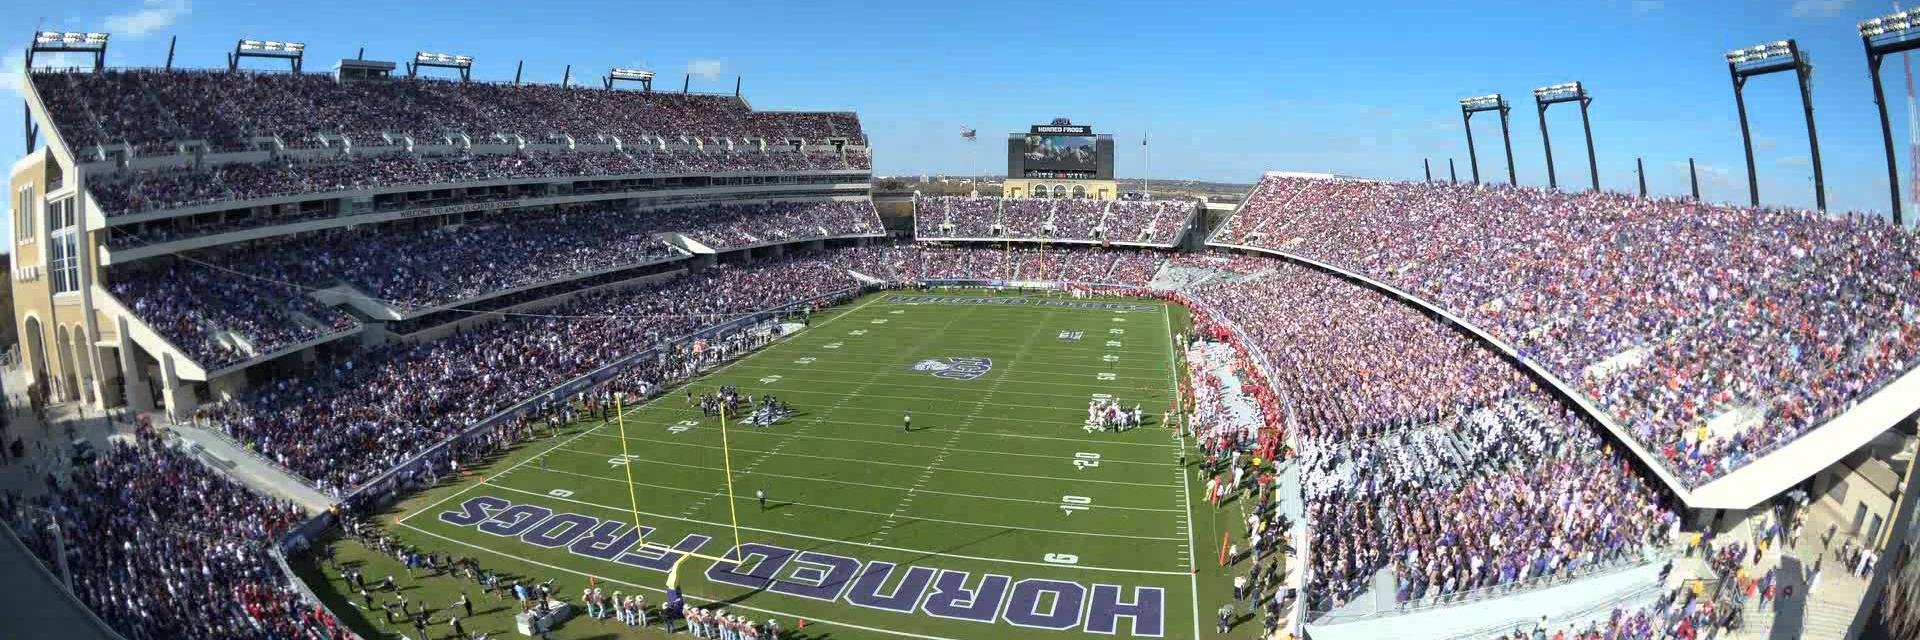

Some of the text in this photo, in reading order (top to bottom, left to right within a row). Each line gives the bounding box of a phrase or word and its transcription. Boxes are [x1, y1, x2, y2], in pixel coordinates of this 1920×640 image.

[401, 208, 431, 218] WELCOME
[435, 207, 443, 216] TO
[496, 200, 520, 209] STADIUM
[1072, 452, 1101, 467] 20
[1060, 495, 1092, 510] 10
[1043, 552, 1079, 565] G
[438, 495, 1166, 638] HORNED FROGS
